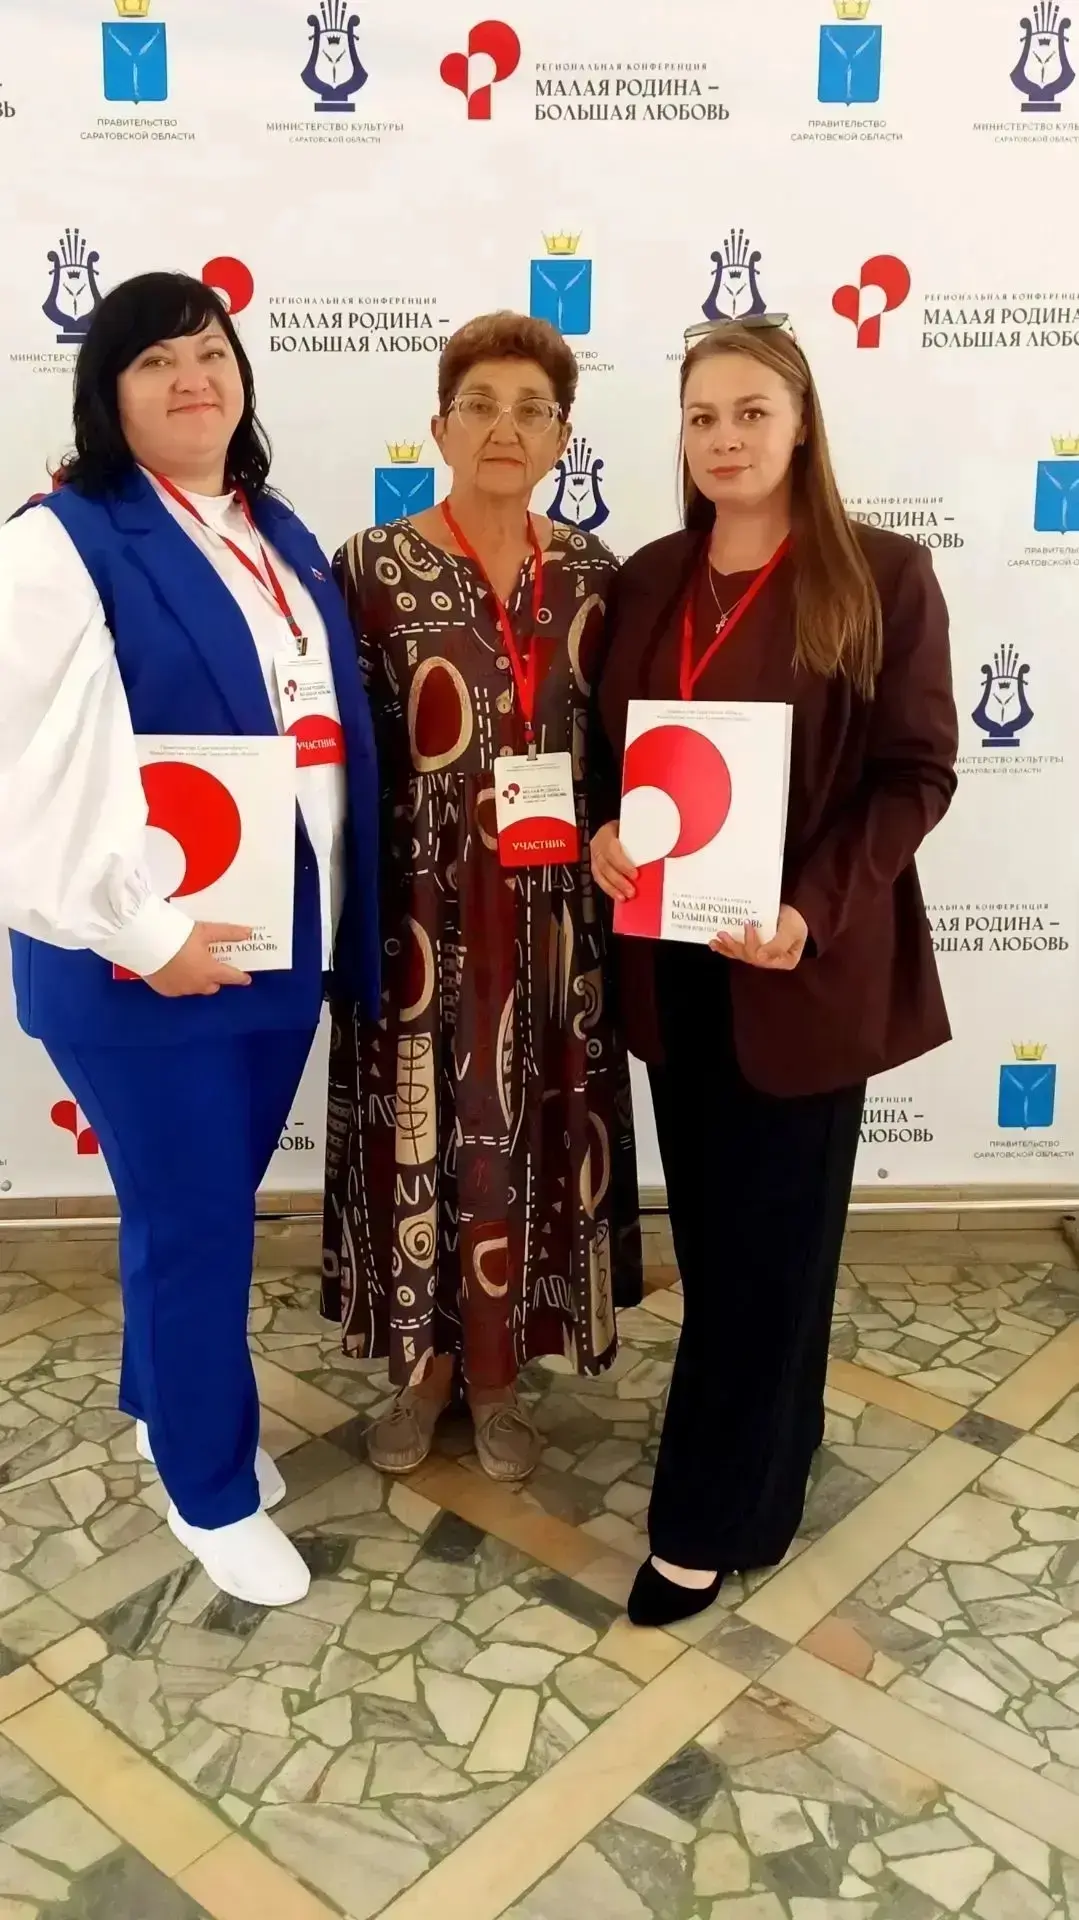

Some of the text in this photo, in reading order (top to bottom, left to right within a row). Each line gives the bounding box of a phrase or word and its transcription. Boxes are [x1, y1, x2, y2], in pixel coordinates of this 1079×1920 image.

[536, 63, 707, 71] РЕГИОНАЛЬНАЯ КОНФЕРЕНЦИЯ
[535, 79, 609, 96] МАЛАЯ
[616, 79, 702, 97] РОДИНА
[535, 104, 730, 121] БОЛЬШАЯ ЛЮБОВЬ
[97, 118, 177, 127] ПРАВИТЕЛЬСТВО
[266, 122, 348, 131] МИНИСТЕРСТВО
[808, 119, 887, 128] ПРАВИТЕЛЬСТВО
[80, 131, 195, 140] САРАТОВСКОЙ ОБЛАСТИ
[791, 132, 858, 141] САРАТОВСКОЙ
[269, 297, 437, 305] РЕГИОНАЛЬНАЯ КОНФЕРЕНЦИЯ
[270, 312, 342, 329] МАЛАЯ
[348, 312, 433, 330] РОДИНА
[924, 308, 995, 325] МАЛАЯ
[270, 335, 369, 352] БОЛЬШАЯ
[921, 331, 1021, 348] БОЛЬШАЯ
[579, 363, 615, 371] БЛАСТИ
[856, 511, 938, 528] РОДИНА
[297, 738, 337, 750] УЧАСТНИК
[512, 839, 567, 851] УЧАСТНИК
[672, 900, 706, 912] МАЛАЯ
[708, 903, 749, 916] РОДИНА
[965, 916, 1044, 932] РОДИНА
[235, 943, 278, 952] ЛЮБОВЬ
[989, 937, 1069, 951] ЛЮБОВЬ
